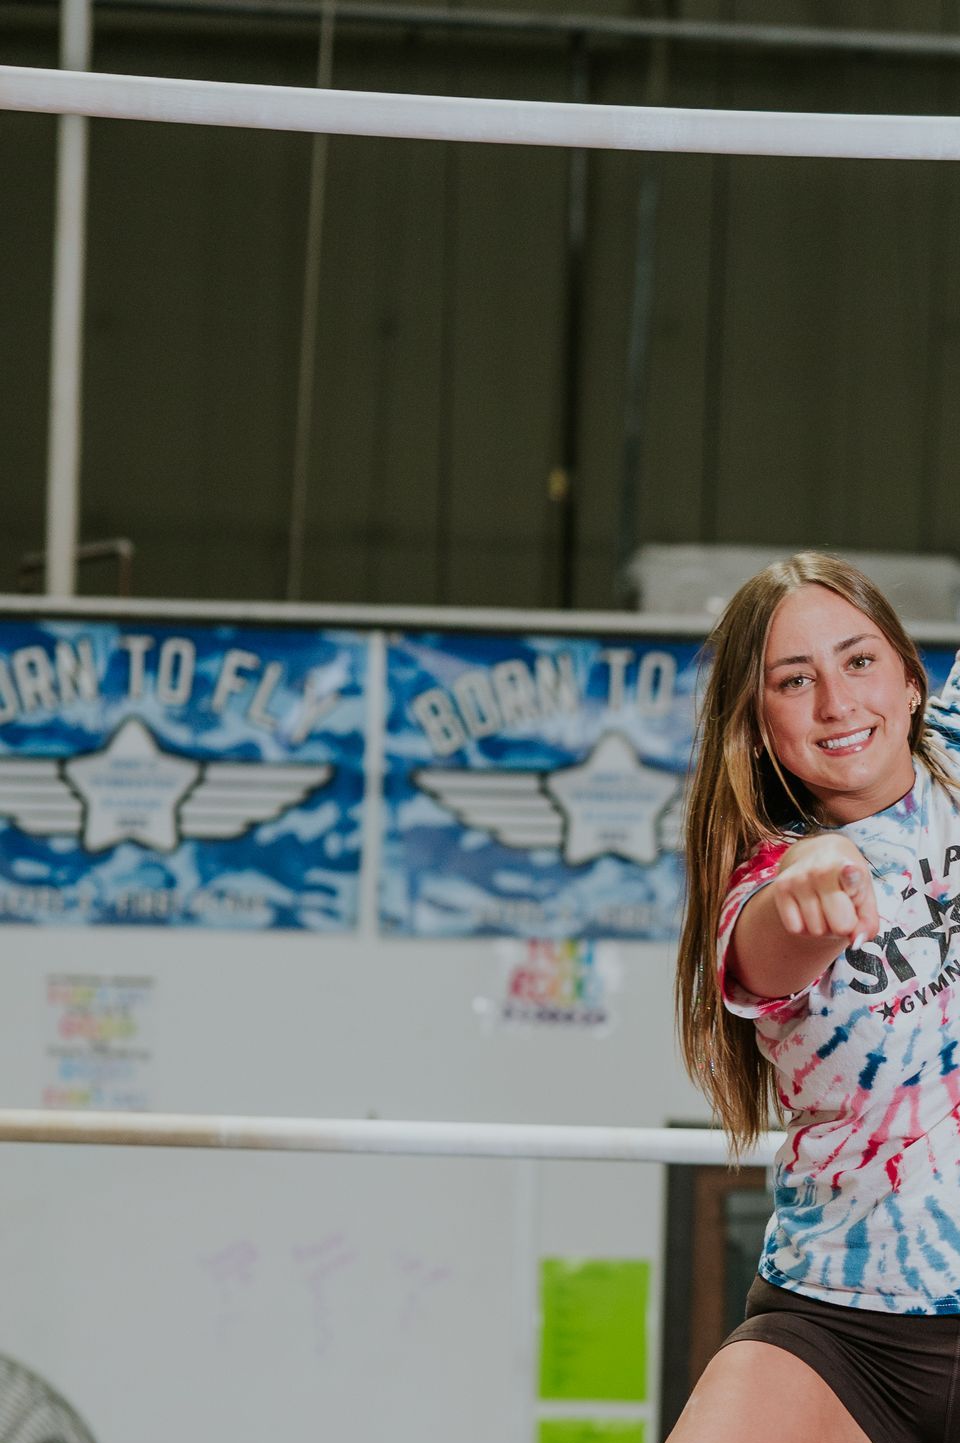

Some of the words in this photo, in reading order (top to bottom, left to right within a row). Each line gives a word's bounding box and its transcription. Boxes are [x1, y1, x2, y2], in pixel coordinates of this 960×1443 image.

[119, 634, 197, 706] TO
[211, 649, 345, 746] FLY
[411, 653, 580, 758] BORN
[600, 647, 677, 715] TO
